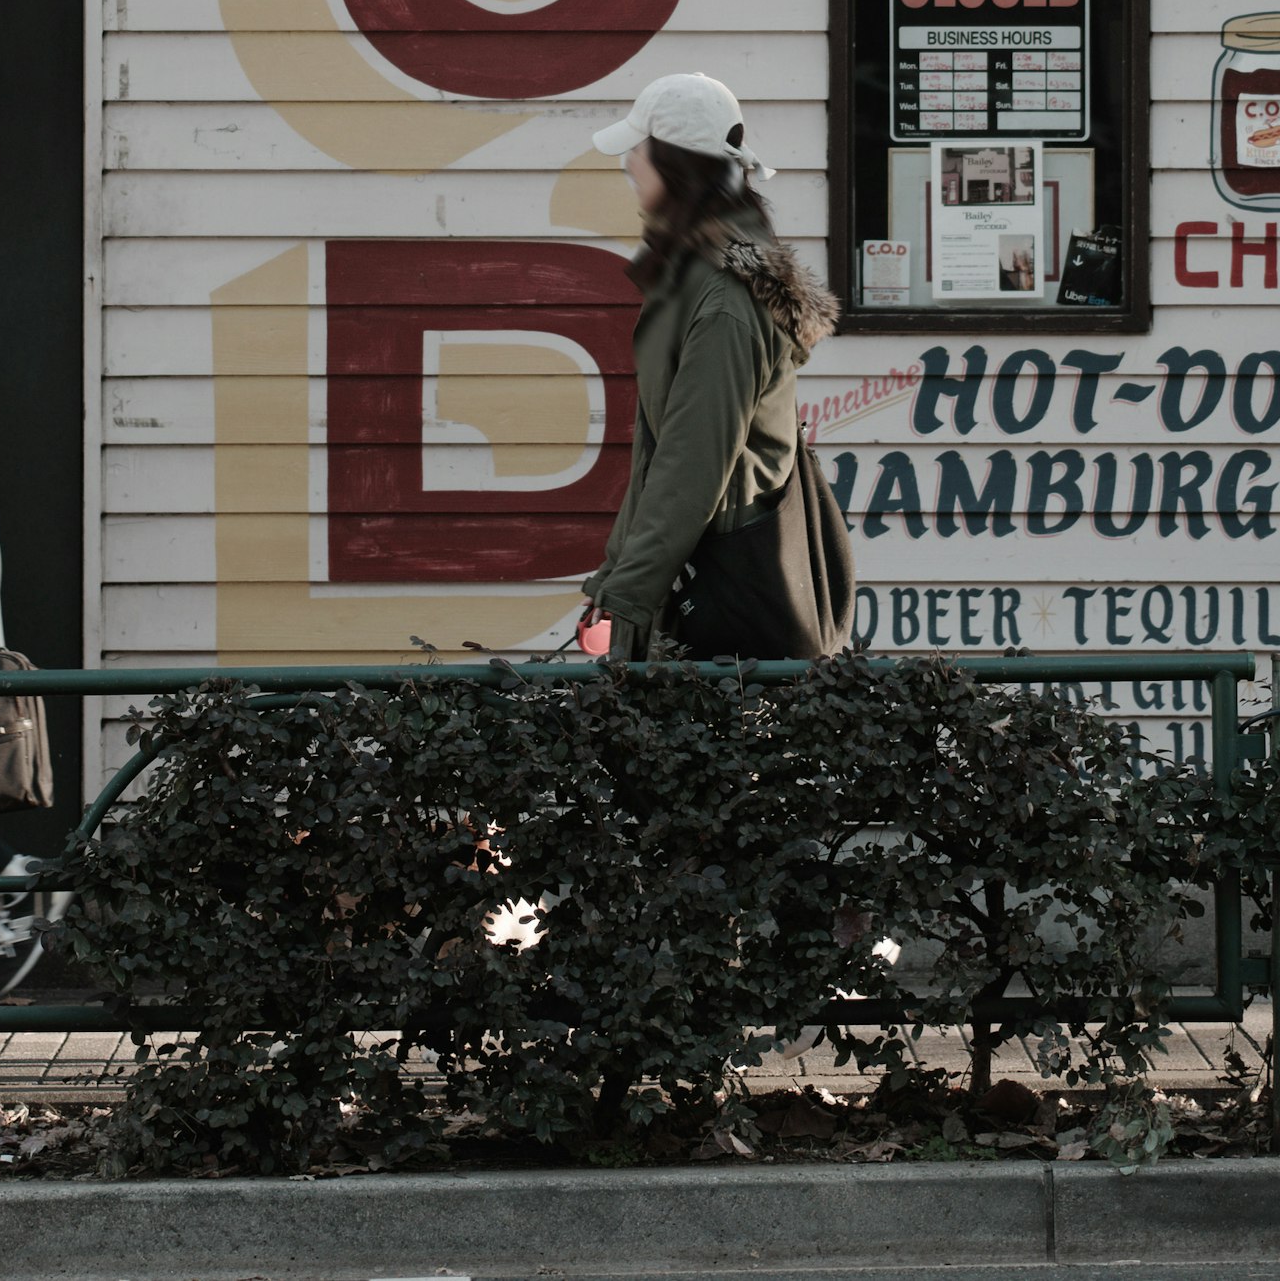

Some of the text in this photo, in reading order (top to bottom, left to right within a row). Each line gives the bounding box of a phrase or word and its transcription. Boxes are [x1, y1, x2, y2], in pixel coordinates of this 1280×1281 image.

[927, 31, 1053, 45] BUSINESS HOURS
[899, 62, 918, 70] Mon.
[899, 82, 915, 90] Tue.
[995, 82, 1010, 90] Sat.
[899, 102, 918, 110] Wed.
[899, 122, 916, 130] Thu.
[866, 243, 907, 256] C.O.D
[1064, 289, 1088, 302] Uber
